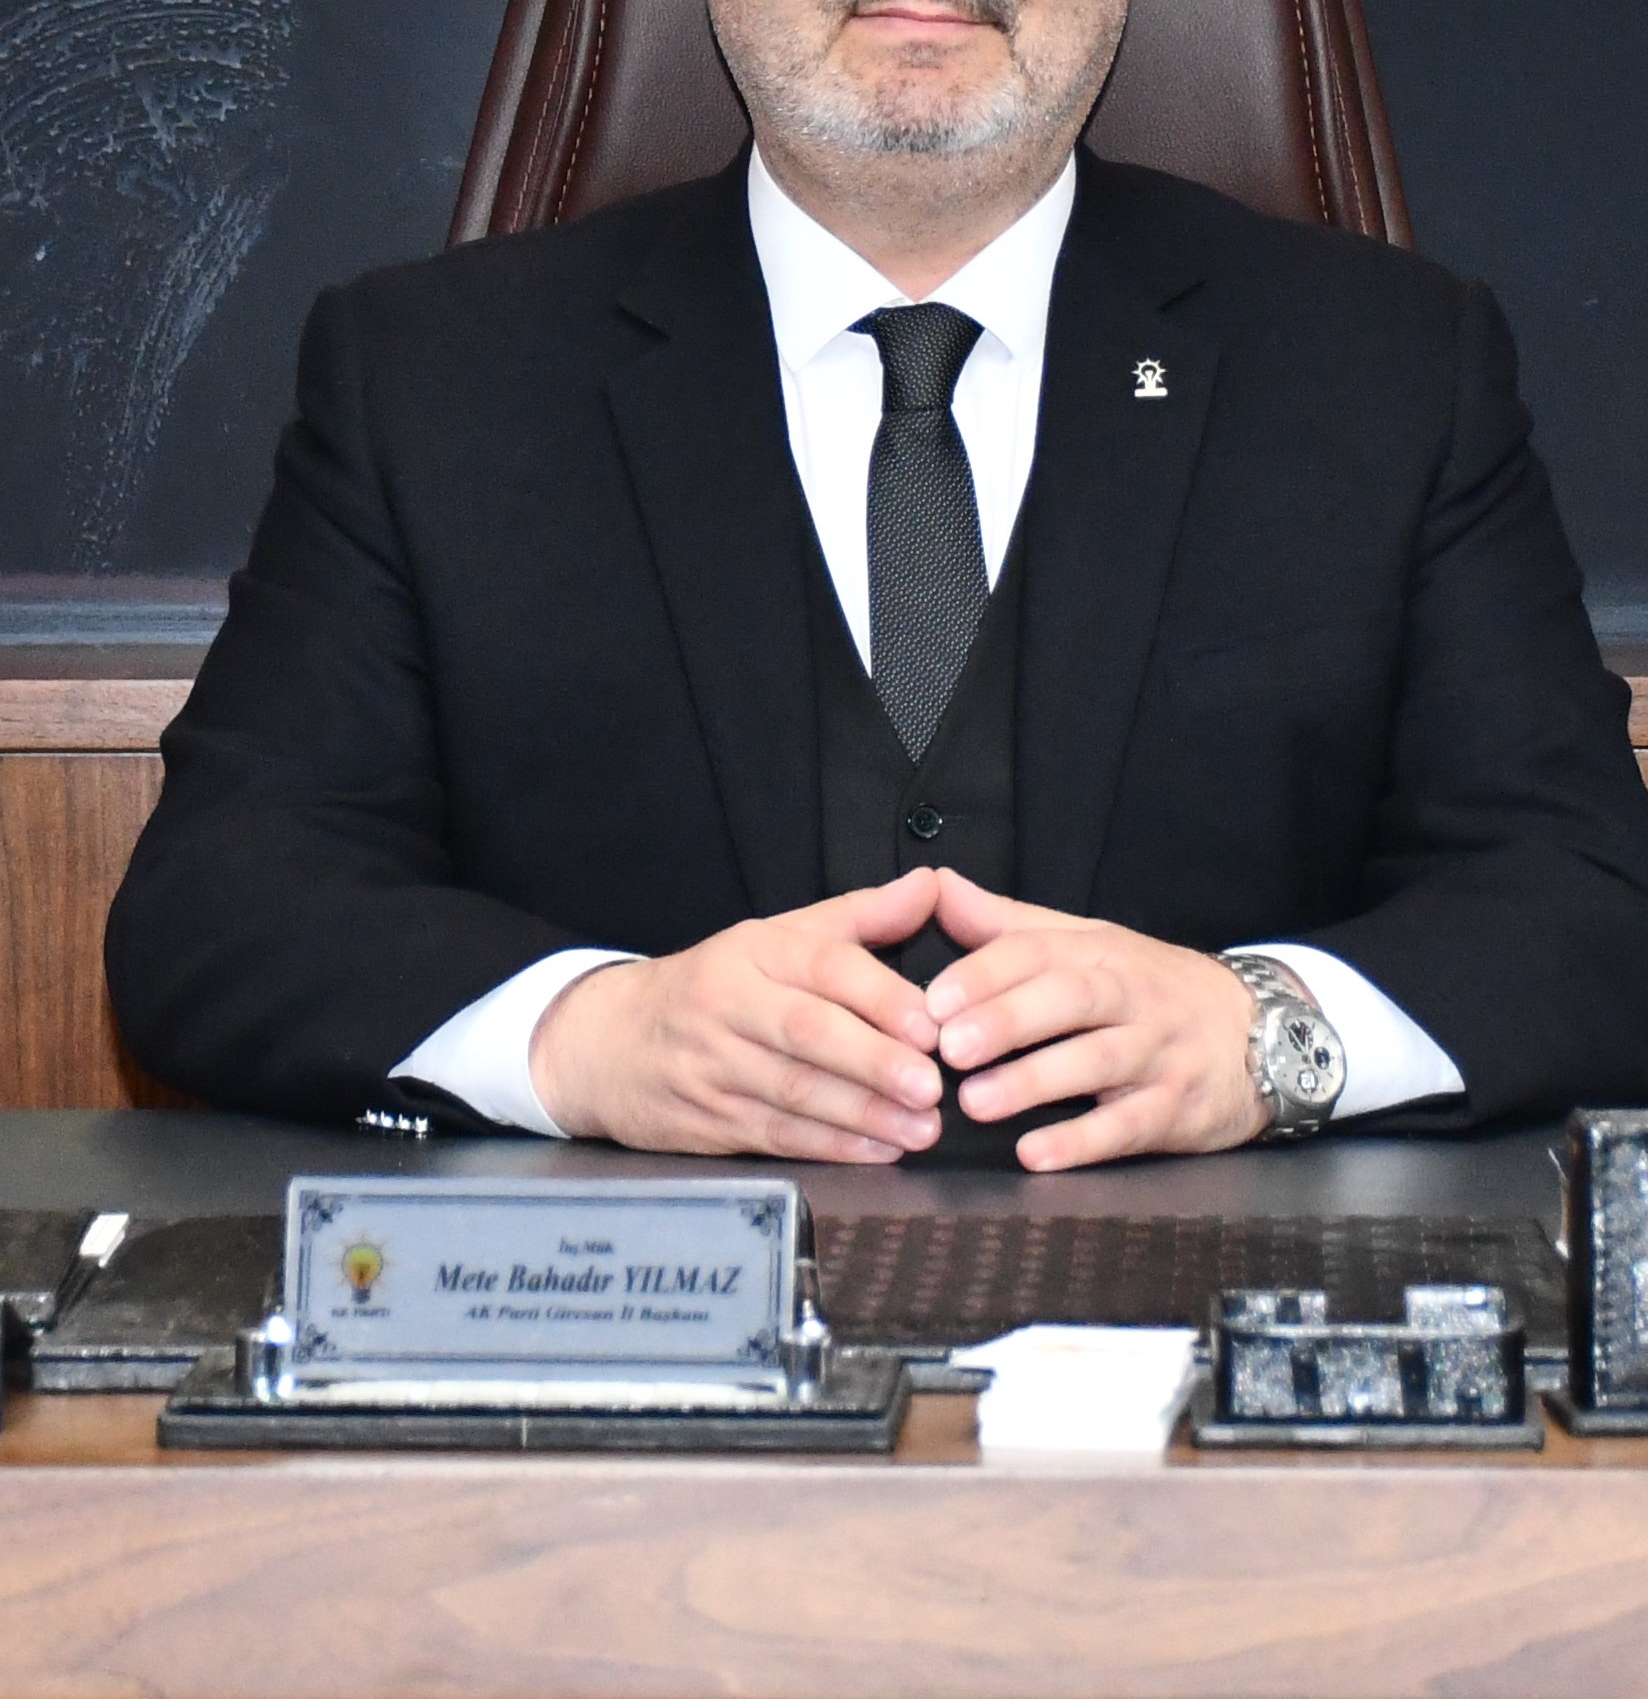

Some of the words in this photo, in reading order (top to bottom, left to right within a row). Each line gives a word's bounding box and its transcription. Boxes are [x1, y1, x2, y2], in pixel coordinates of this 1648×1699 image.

[434, 1262, 499, 1292] Mete
[625, 1263, 743, 1294] YILMAZ
[465, 1304, 493, 1320] AK
[497, 1304, 540, 1321] Parti
